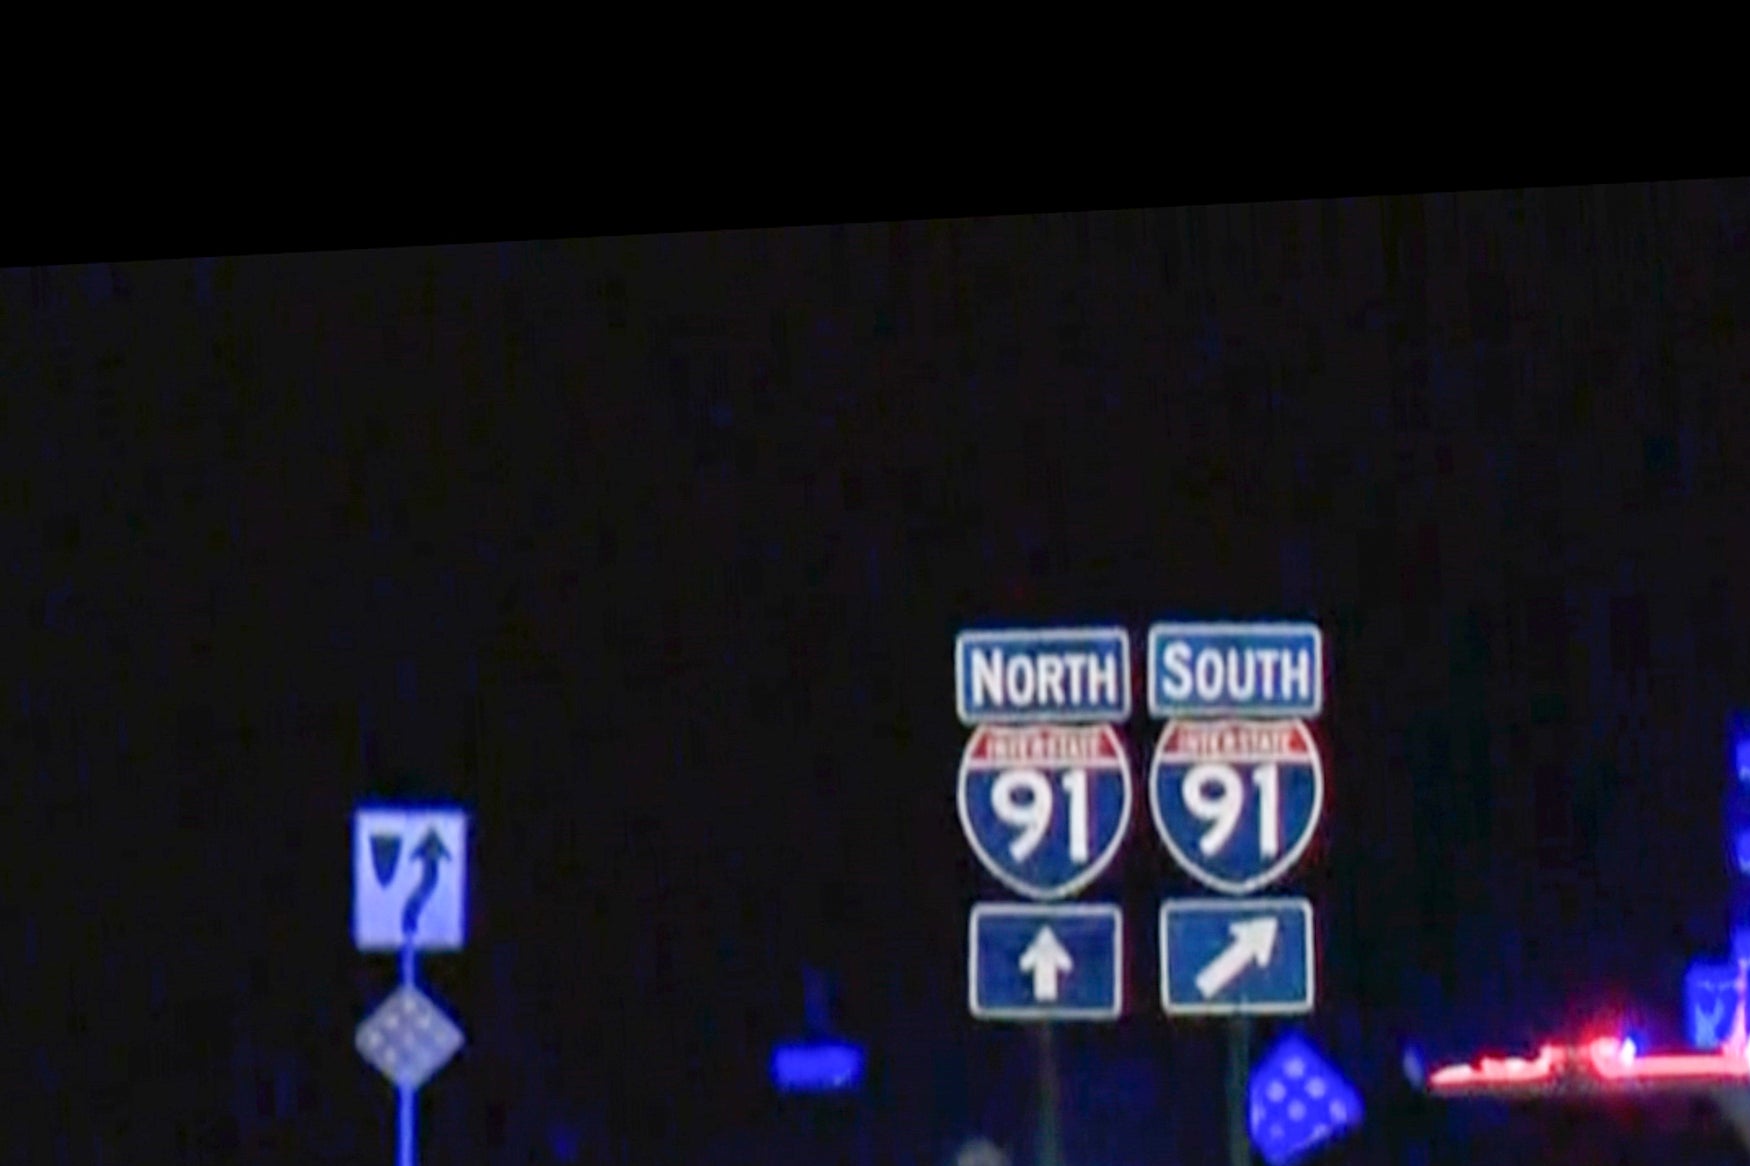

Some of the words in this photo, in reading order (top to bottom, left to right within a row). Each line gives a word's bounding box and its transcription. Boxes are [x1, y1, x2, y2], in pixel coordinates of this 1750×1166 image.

[971, 648, 1117, 706] NORTH
[1162, 640, 1310, 700] SOUTH
[990, 769, 1089, 863] 91
[1182, 764, 1279, 860] 91
